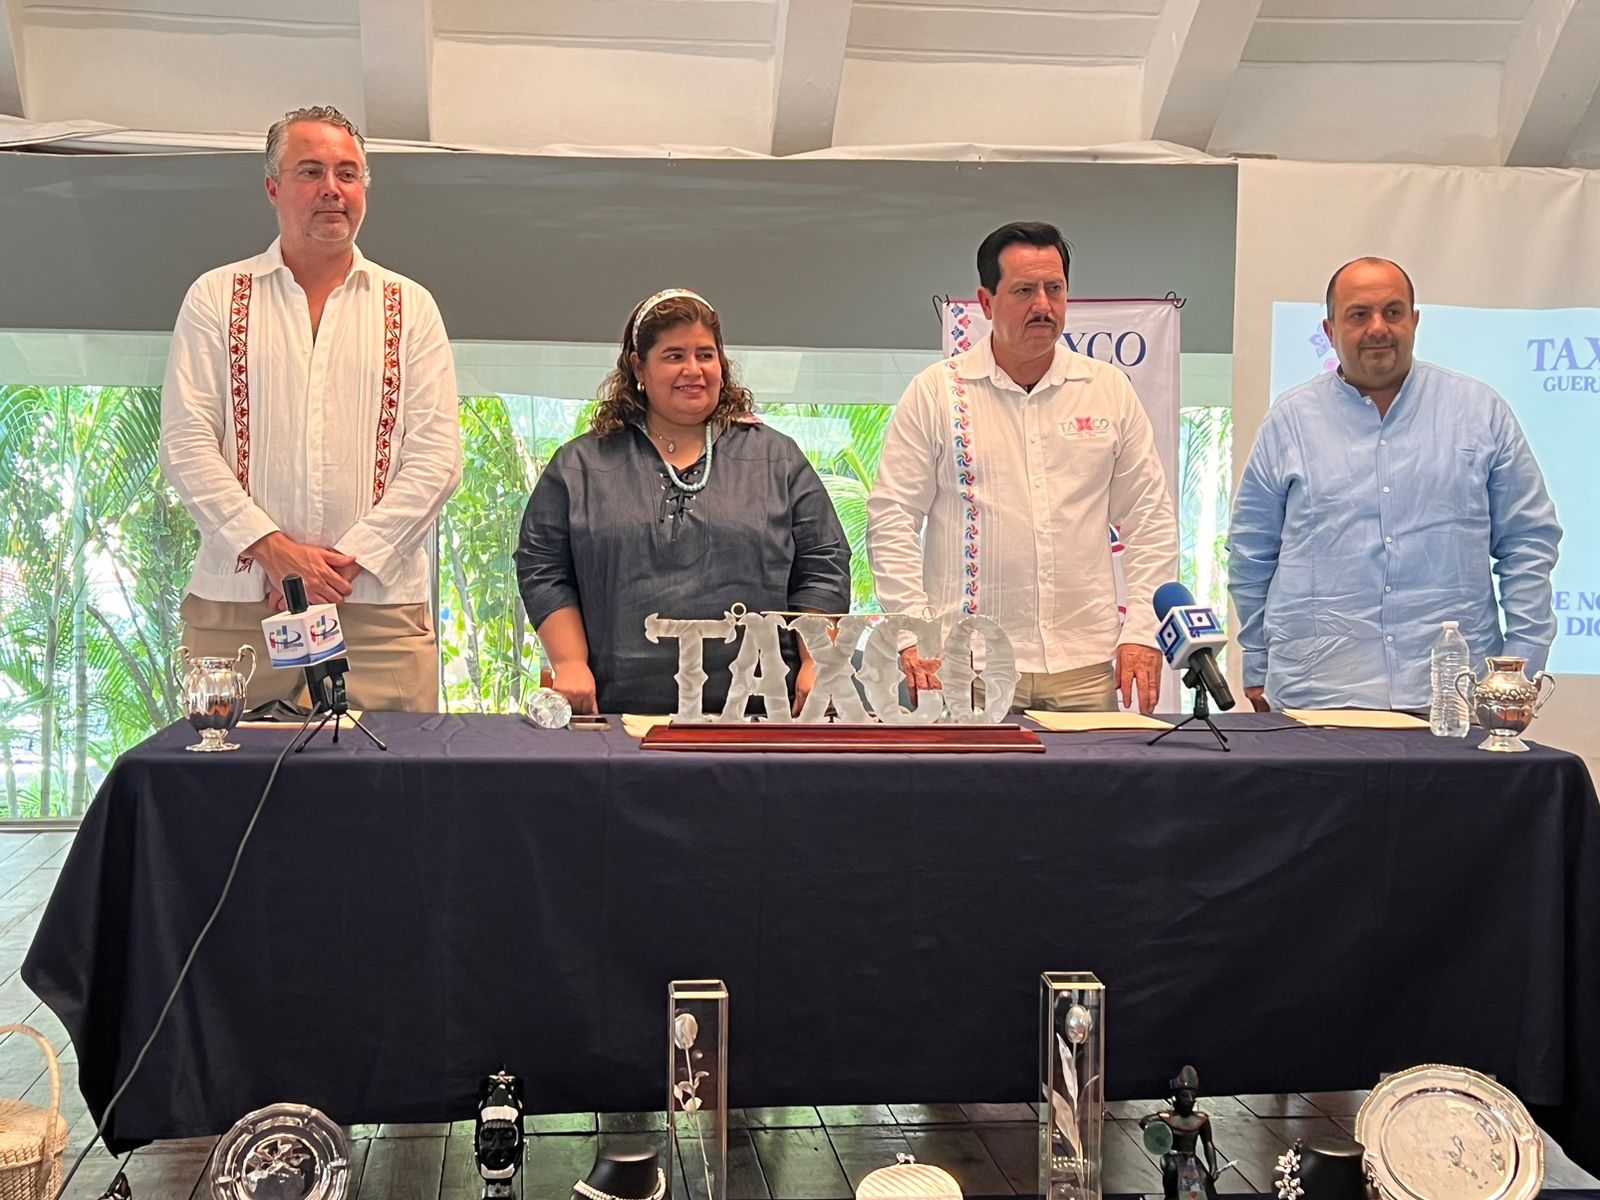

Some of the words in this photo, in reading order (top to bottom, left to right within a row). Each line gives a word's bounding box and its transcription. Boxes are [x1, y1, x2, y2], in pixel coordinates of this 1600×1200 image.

[1543, 376, 1600, 393] GUER
[1551, 591, 1570, 611] E
[1577, 591, 1600, 611] N
[644, 610, 1022, 724] TAXCO
